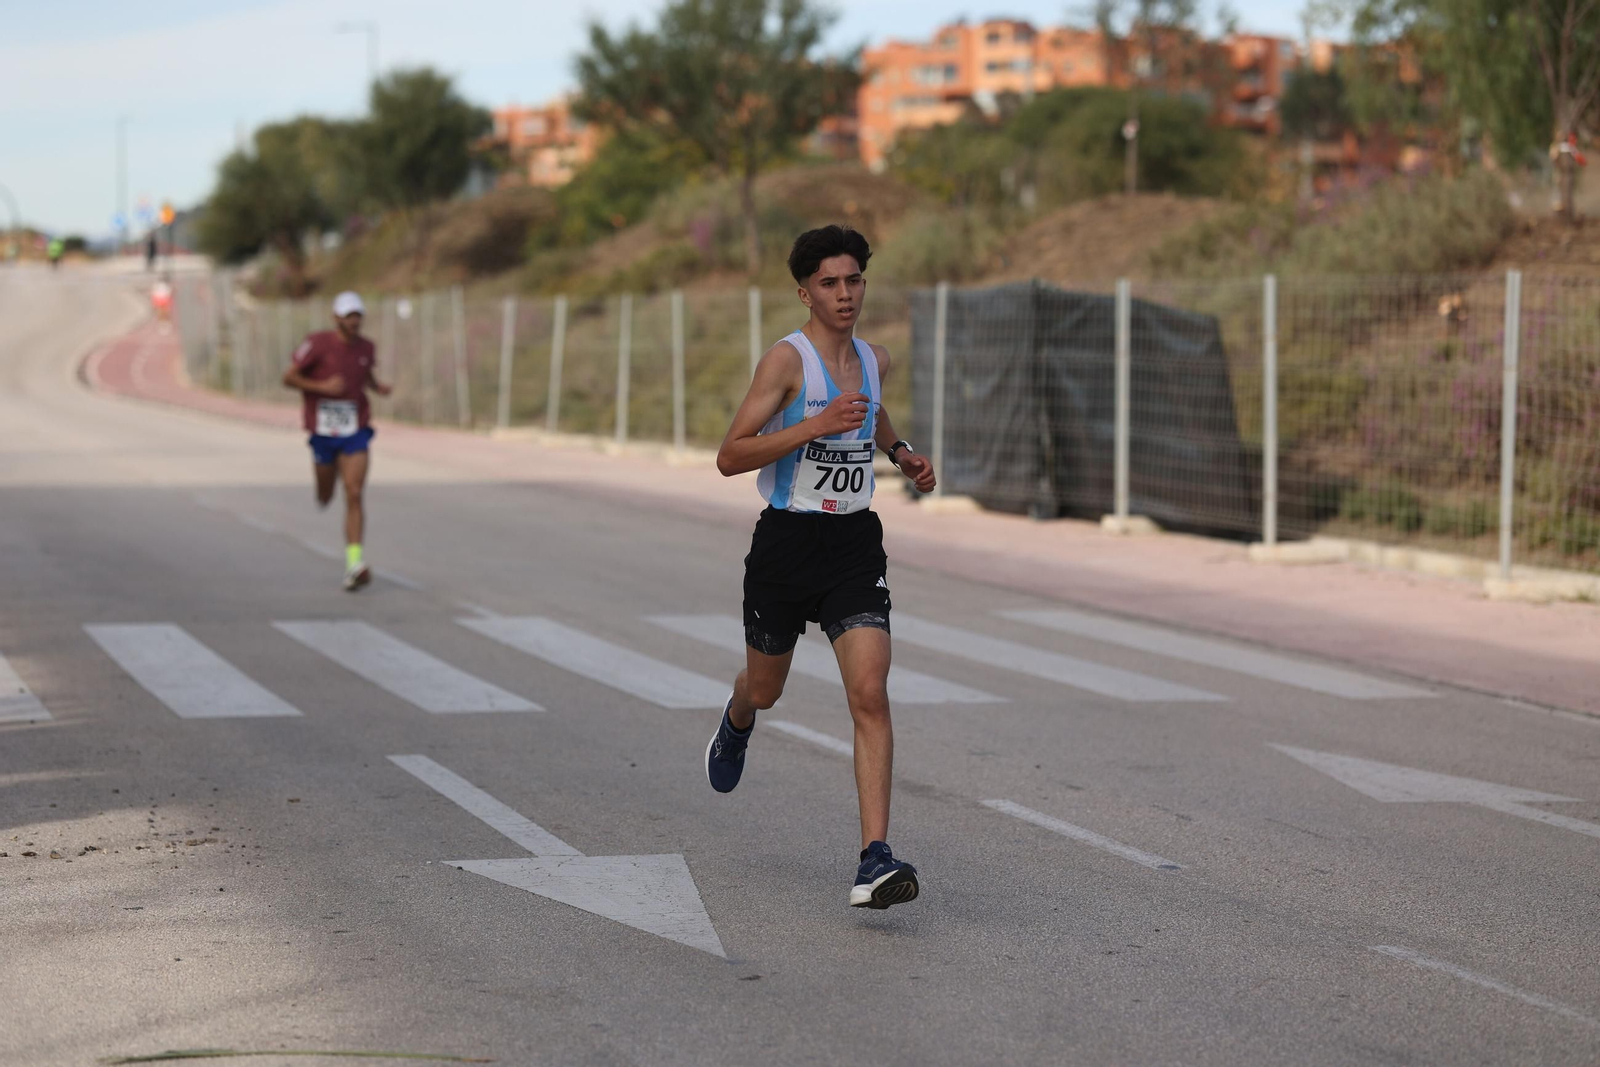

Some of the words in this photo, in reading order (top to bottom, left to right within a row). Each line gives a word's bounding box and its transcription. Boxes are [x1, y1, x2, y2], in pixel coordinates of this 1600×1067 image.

[807, 399, 827, 407] vive
[809, 449, 843, 462] UMA
[813, 465, 864, 493] 700
